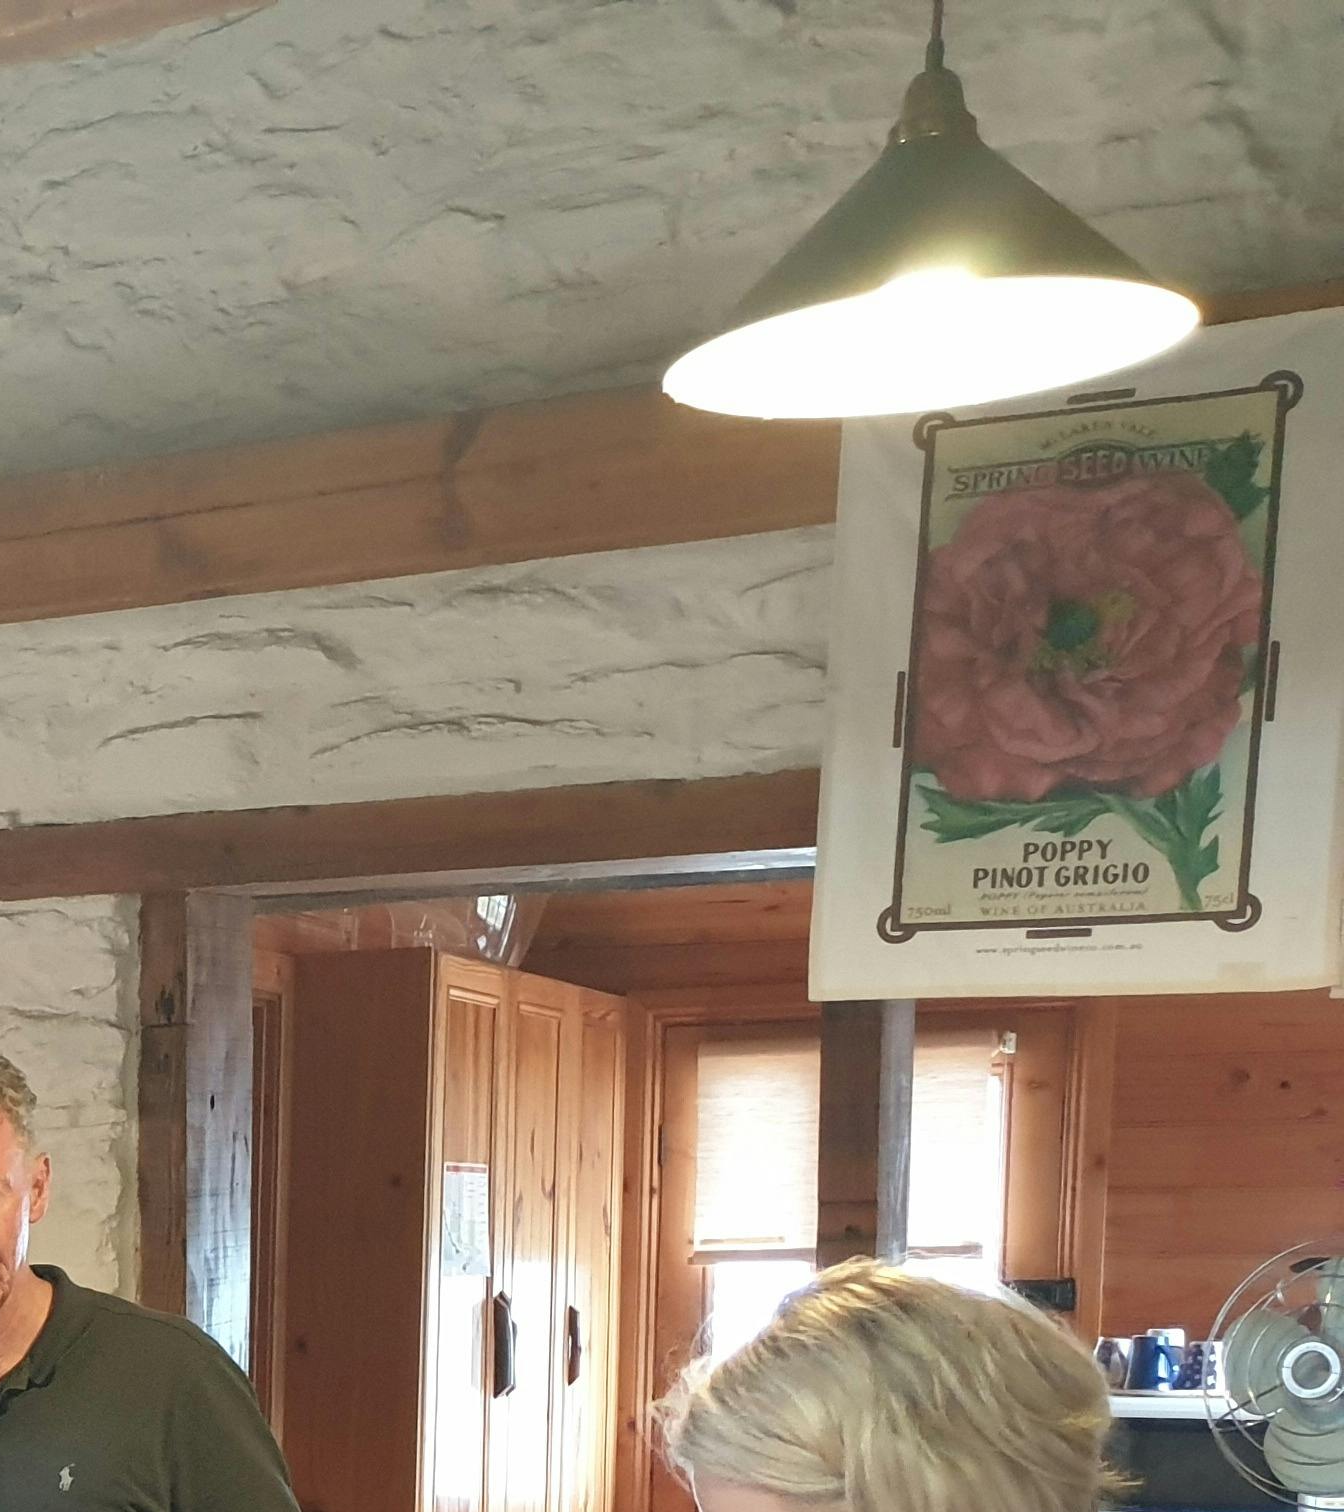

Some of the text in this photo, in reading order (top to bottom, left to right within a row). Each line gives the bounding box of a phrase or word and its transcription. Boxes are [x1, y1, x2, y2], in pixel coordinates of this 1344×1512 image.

[1064, 450, 1129, 480] SEED
[1022, 838, 1113, 864] POPPY
[972, 861, 1151, 890] PINOT GRIGIO
[907, 903, 952, 919] 750ml
[979, 906, 1018, 918] WINE
[1026, 904, 1048, 916] OF
[1053, 900, 1148, 915] AUSTRALIA
